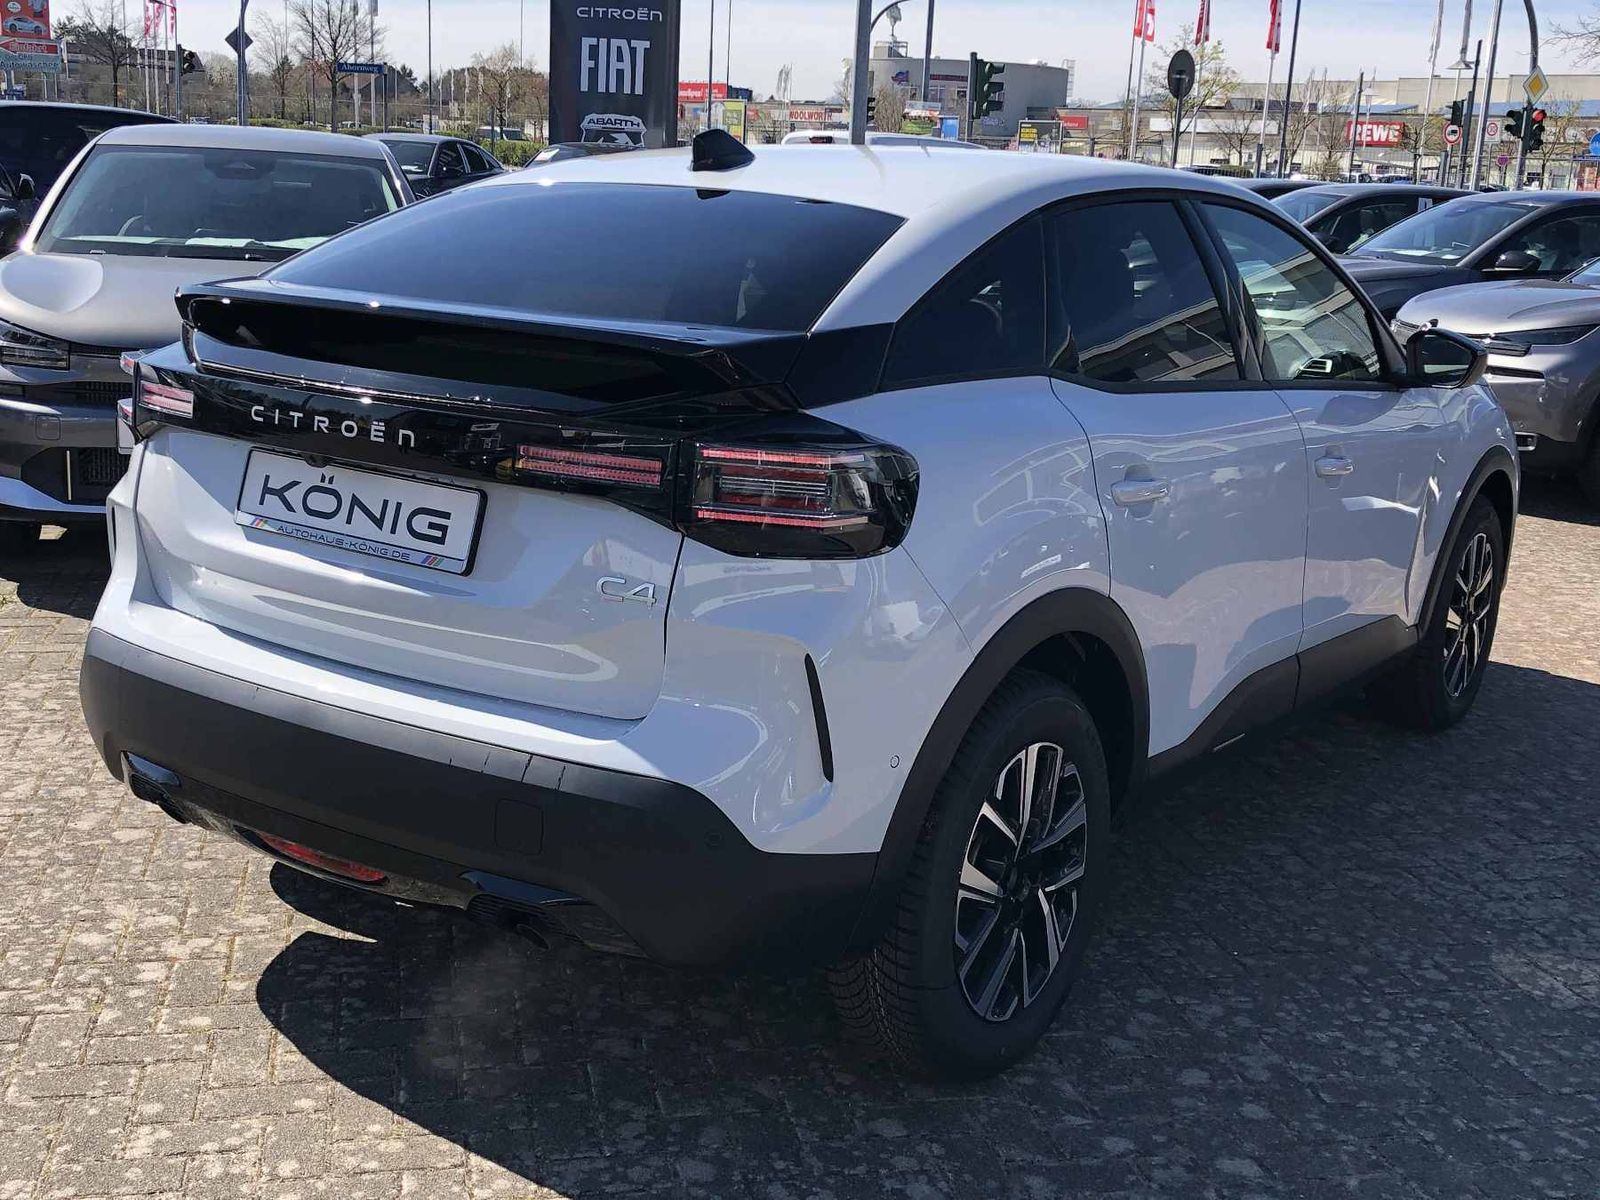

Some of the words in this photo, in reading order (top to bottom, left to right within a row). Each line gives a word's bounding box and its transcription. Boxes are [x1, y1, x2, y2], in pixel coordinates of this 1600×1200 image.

[576, 7, 663, 22] CITROËN
[580, 36, 651, 95] FIAT
[587, 117, 640, 128] ABARTH
[1349, 124, 1401, 142] REWE
[251, 405, 416, 448] CITROËN
[258, 472, 452, 546] KÖNIG
[596, 576, 657, 610] C4
